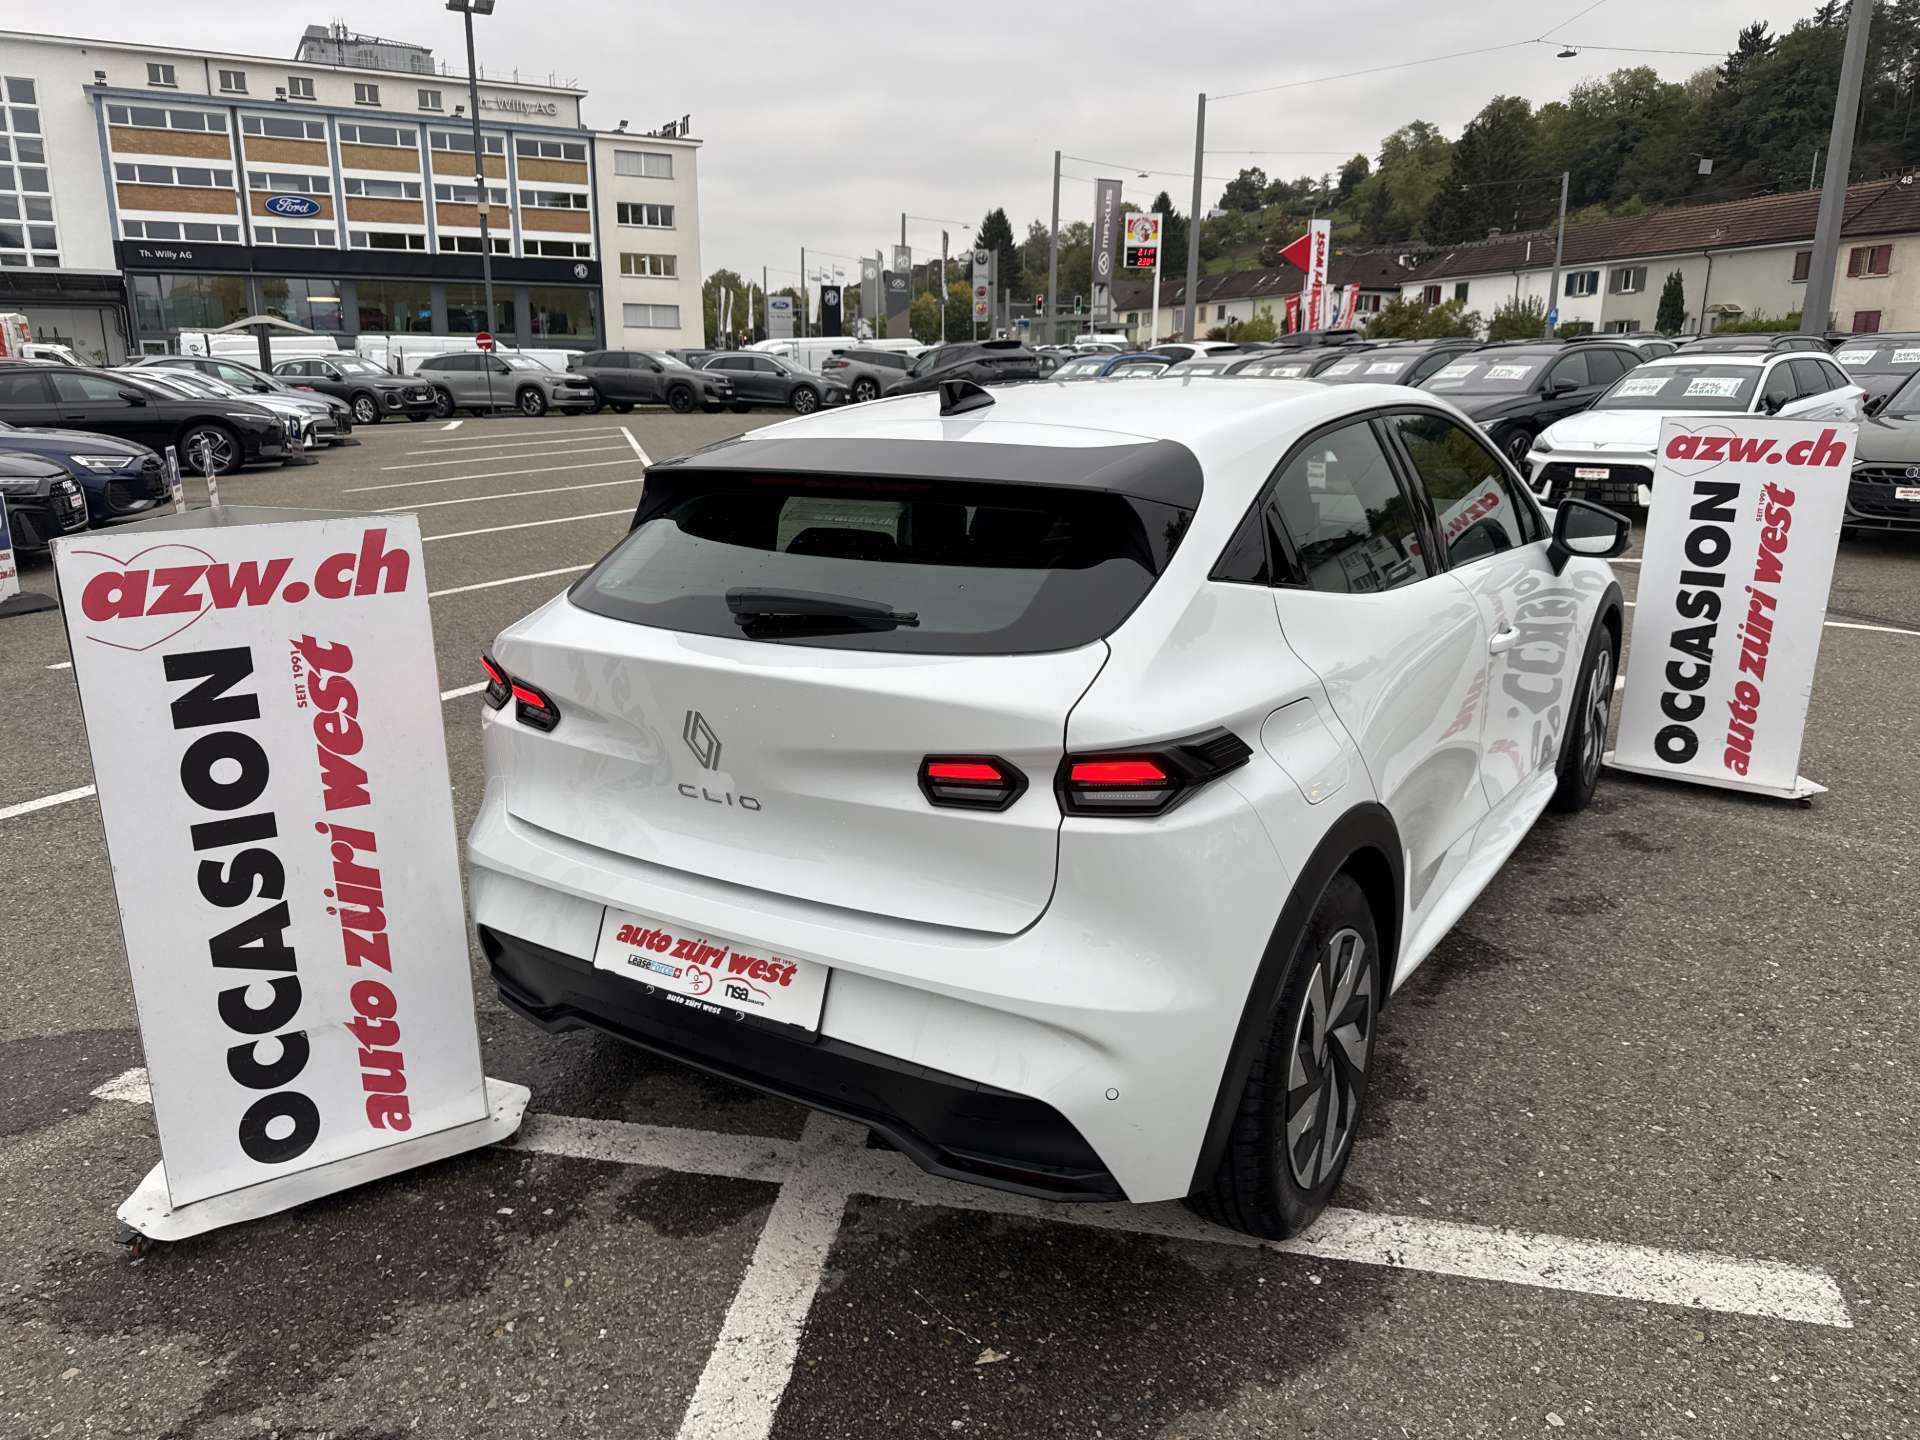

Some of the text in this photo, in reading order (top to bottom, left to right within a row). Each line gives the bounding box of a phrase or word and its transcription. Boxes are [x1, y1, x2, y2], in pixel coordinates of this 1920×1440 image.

[496, 96, 530, 115] Willy
[535, 103, 557, 115] AG
[1900, 175, 1913, 185] 48
[275, 197, 309, 213] Ford
[139, 249, 193, 260] Th. Willy AG
[574, 263, 588, 279] MG
[1665, 429, 1848, 467] azw.ch
[1756, 508, 1764, 522] SEIT
[81, 528, 410, 622] azw.ch
[1654, 480, 1741, 765] OCCASION
[1723, 481, 1796, 777] auto züri west
[289, 650, 308, 709] SEIT 1991
[678, 783, 761, 811] CLIO
[289, 633, 413, 1132] auto züri west
[162, 646, 320, 1165] OCCASION
[616, 923, 798, 987] auto züri west
[666, 993, 721, 1015] auto züri west
[725, 984, 749, 1001] nsa
